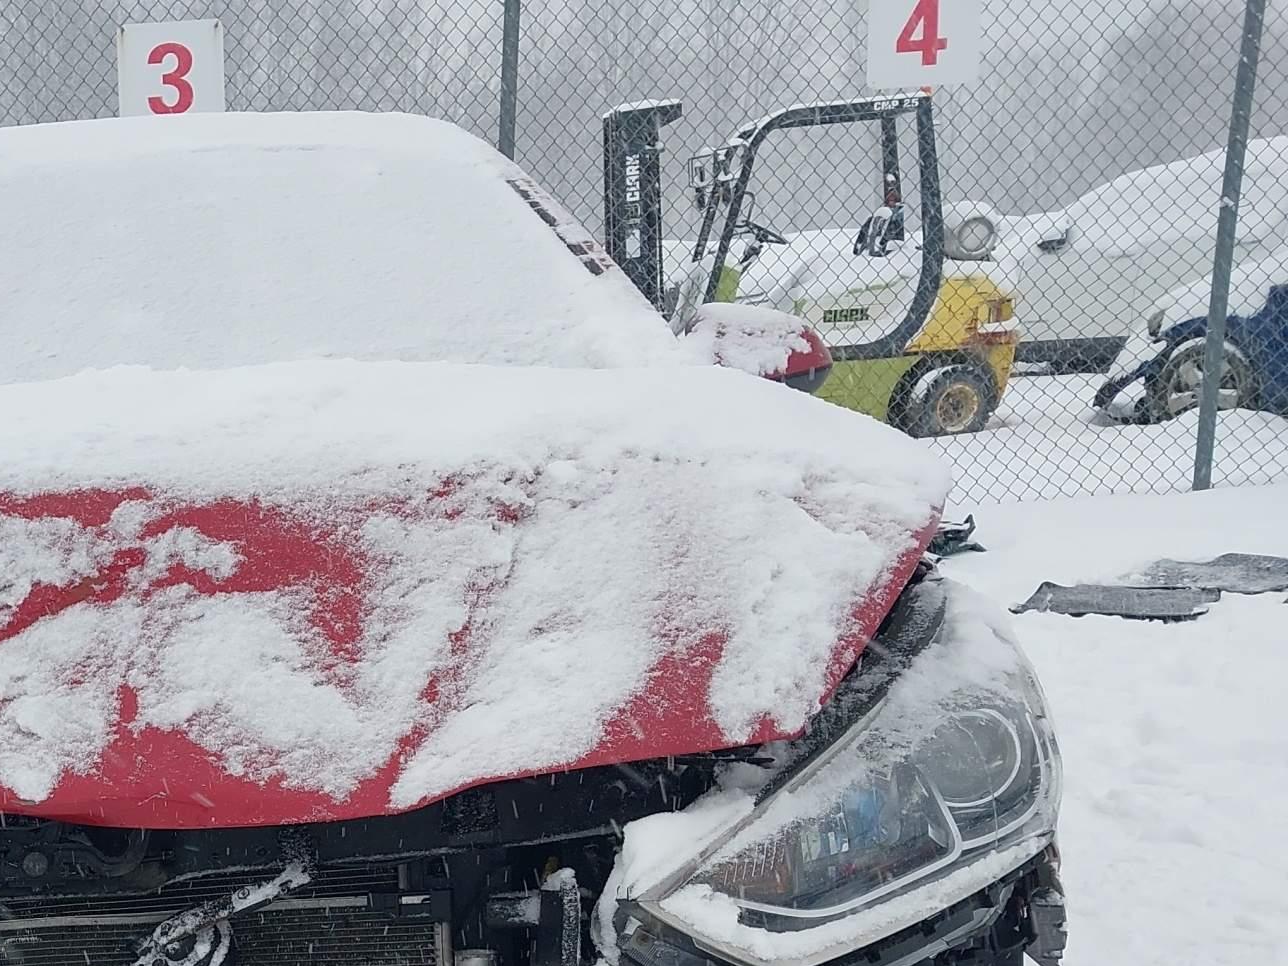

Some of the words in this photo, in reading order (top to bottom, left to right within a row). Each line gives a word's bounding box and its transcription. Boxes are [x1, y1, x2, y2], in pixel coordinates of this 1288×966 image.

[896, 0, 947, 65] 4
[147, 42, 194, 114] 3
[625, 153, 641, 202] CLARK
[823, 307, 870, 323] CLARK
